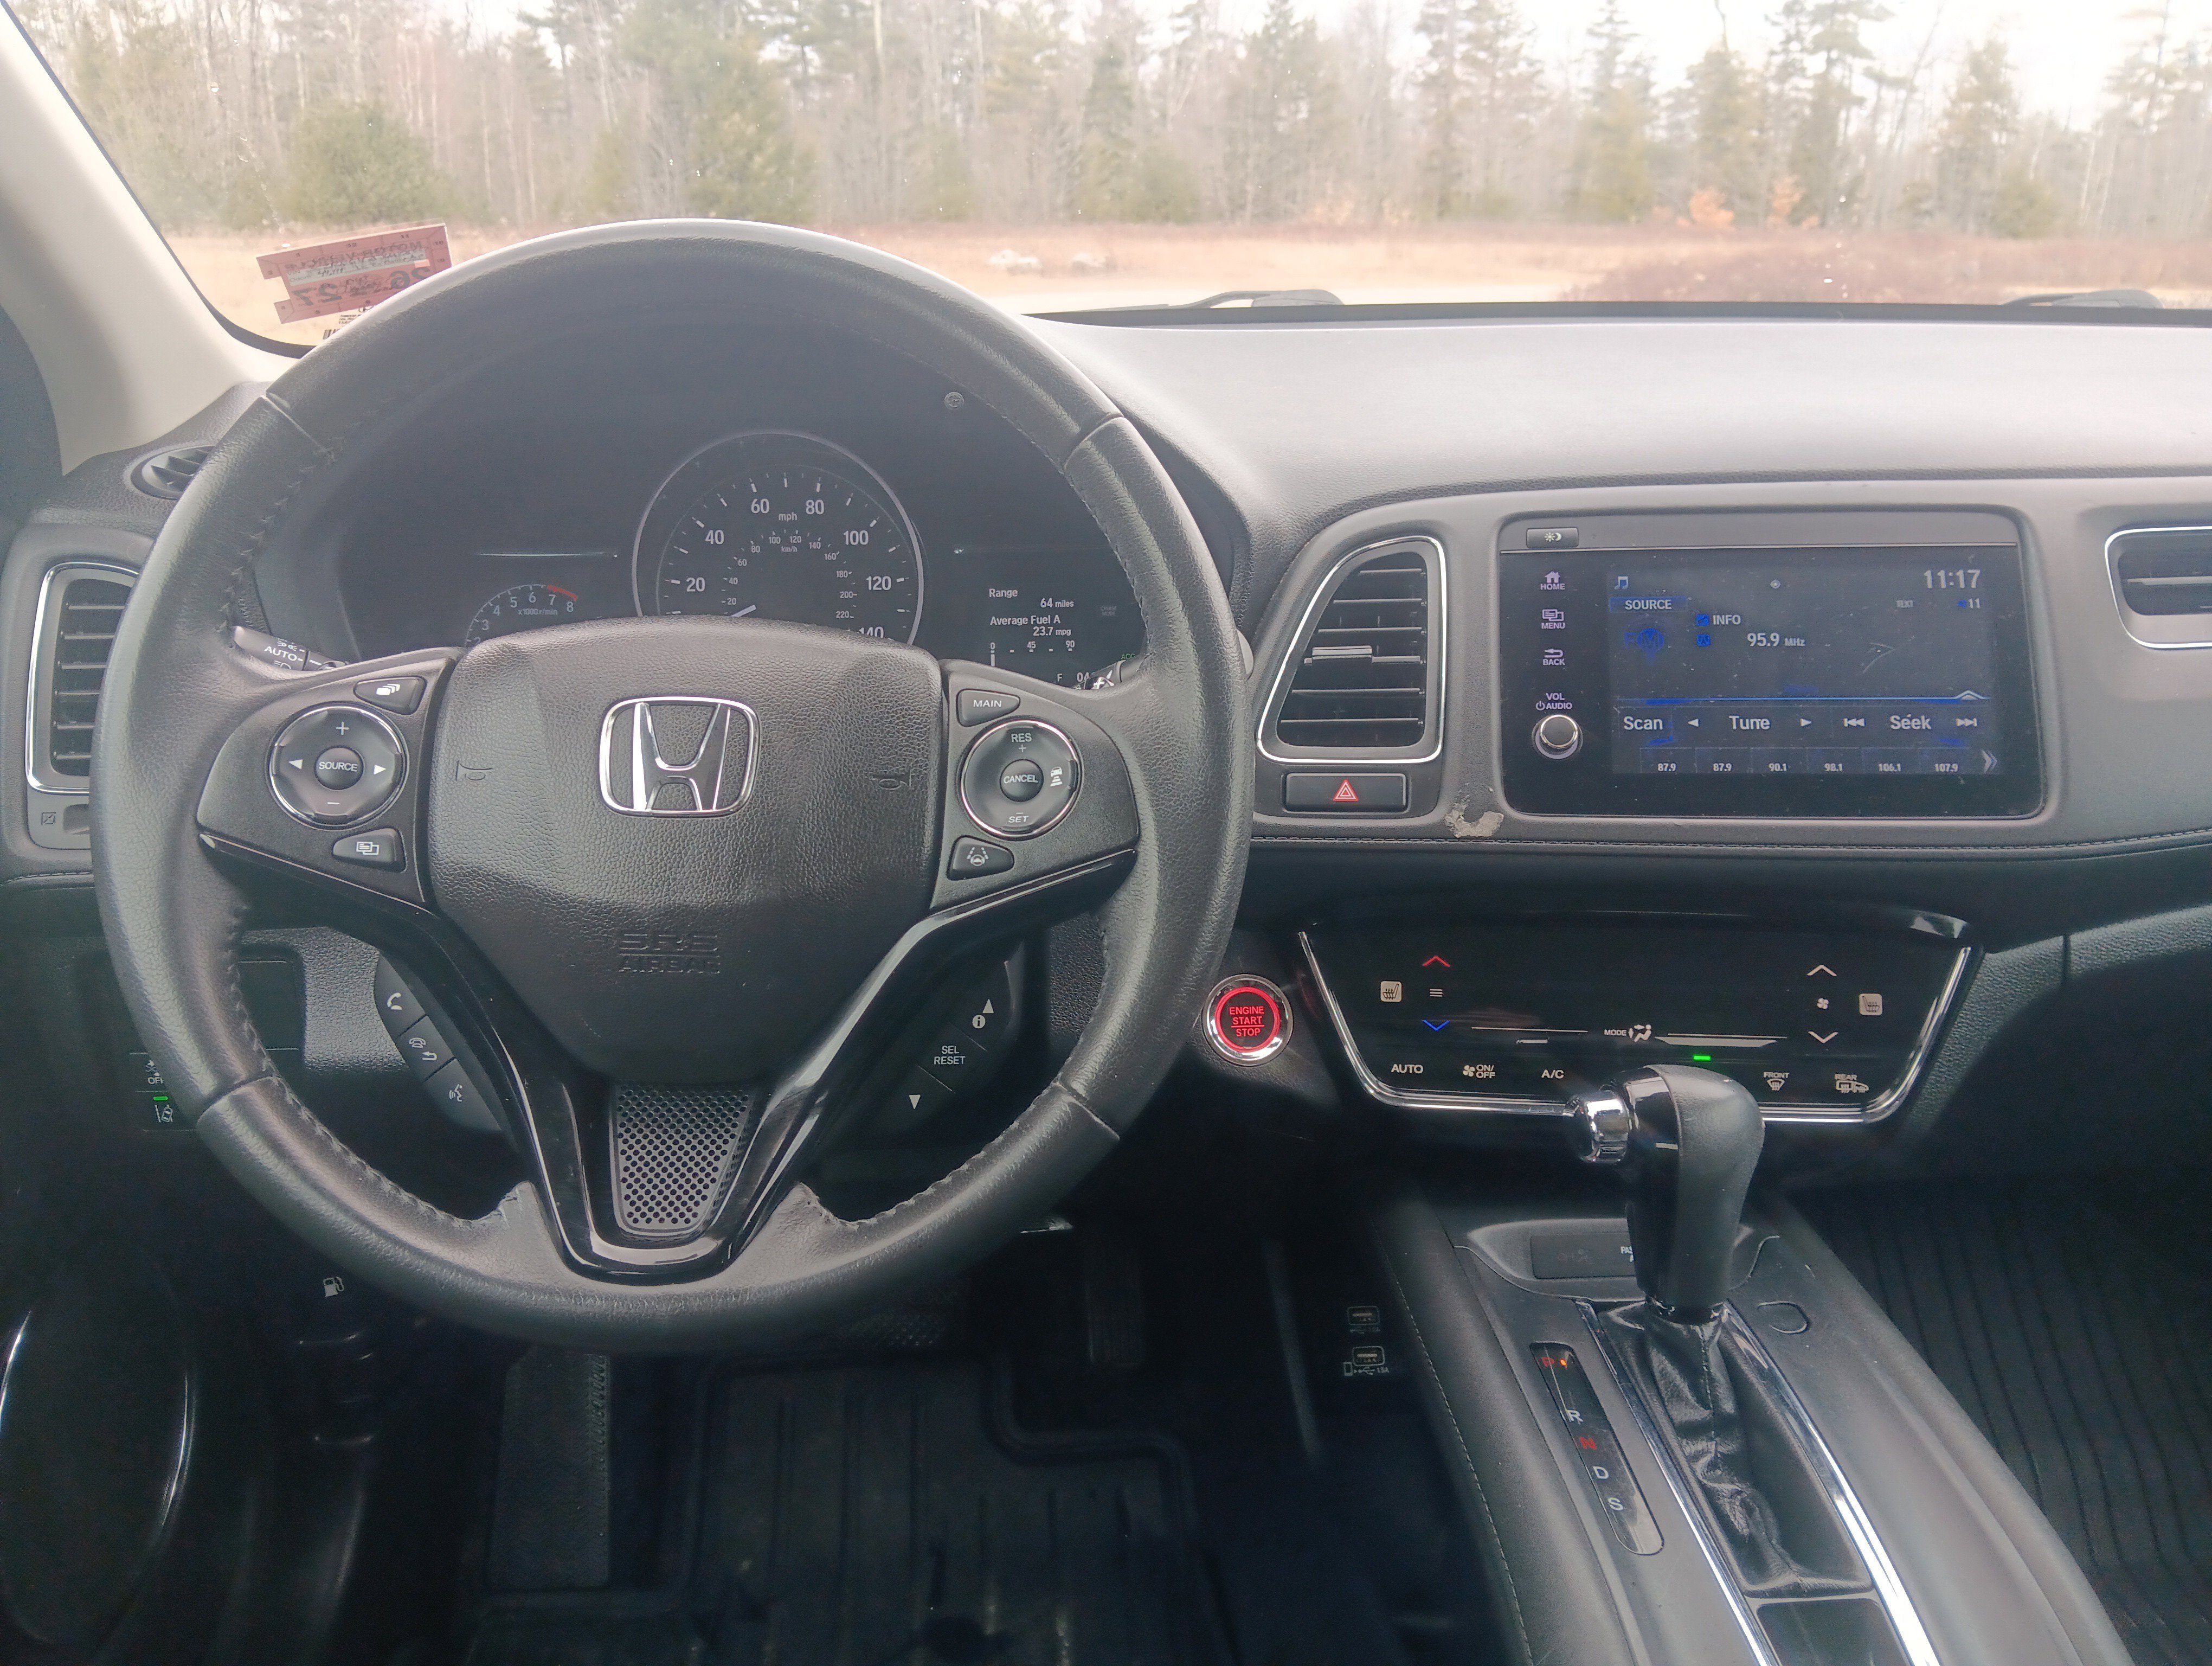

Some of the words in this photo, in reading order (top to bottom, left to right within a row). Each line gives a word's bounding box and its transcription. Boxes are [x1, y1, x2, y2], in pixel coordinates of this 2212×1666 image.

[751, 498, 770, 514] 60
[806, 499, 825, 515] 80
[779, 512, 798, 522] mph
[705, 529, 724, 544] 40
[769, 536, 781, 544] 100
[789, 535, 802, 544] 120
[843, 530, 869, 546] 100
[751, 544, 761, 553] 80
[809, 541, 821, 549] 140
[824, 553, 836, 561] 160
[737, 559, 747, 567] 60
[686, 576, 705, 592] 20
[729, 576, 738, 585] 40
[867, 575, 892, 591] 120
[1924, 569, 1980, 589] 11:17
[529, 592, 536, 603] 6
[840, 591, 853, 599] 200
[989, 588, 1018, 599] Range
[510, 597, 517, 608] 5
[549, 594, 556, 605] 7
[1040, 598, 1053, 608] 64
[1055, 600, 1074, 608] miles
[1625, 600, 1672, 610] SOURCE
[1969, 598, 1980, 608] 11
[493, 605, 500, 616] 4
[567, 601, 574, 612] 8
[481, 619, 488, 631] 3
[990, 616, 1028, 626] Average
[1031, 615, 1051, 624] Fuel
[1053, 614, 1061, 624] A
[1713, 614, 1741, 625] INFO
[1033, 626, 1054, 637] 23.7
[1056, 629, 1071, 637] mpg
[1065, 640, 1075, 648] 90
[1747, 632, 1780, 646] 95.9
[1784, 638, 1805, 646] MHz
[265, 646, 297, 661] AUTO
[1546, 693, 1565, 701] VOL
[973, 700, 1002, 708] MAIN
[1623, 716, 1663, 731] Scan
[1729, 715, 1771, 731] Tune
[1889, 715, 1932, 731] Seek
[1011, 733, 1032, 743] RES
[319, 761, 358, 772] SOURCE
[1657, 762, 1676, 772] 87.9
[1713, 762, 1732, 772] 87.9
[1769, 762, 1787, 772] 90.1
[1824, 762, 1843, 772] 98.1
[1877, 762, 1901, 772] 106.1
[1934, 762, 1959, 772] 107.9
[1004, 774, 1038, 783] CANCEL
[1229, 1006, 1265, 1015] ENGINE
[1232, 1016, 1263, 1025] START
[1236, 1028, 1261, 1037] STOP
[942, 1045, 960, 1054] SEL
[934, 1055, 966, 1065] RESET
[1391, 1064, 1424, 1074] AUTO
[1541, 1069, 1565, 1079] A/C
[1567, 1409, 1584, 1424] R
[1580, 1436, 1597, 1450] N
[1593, 1466, 1610, 1479] D
[1607, 1497, 1623, 1511] S
